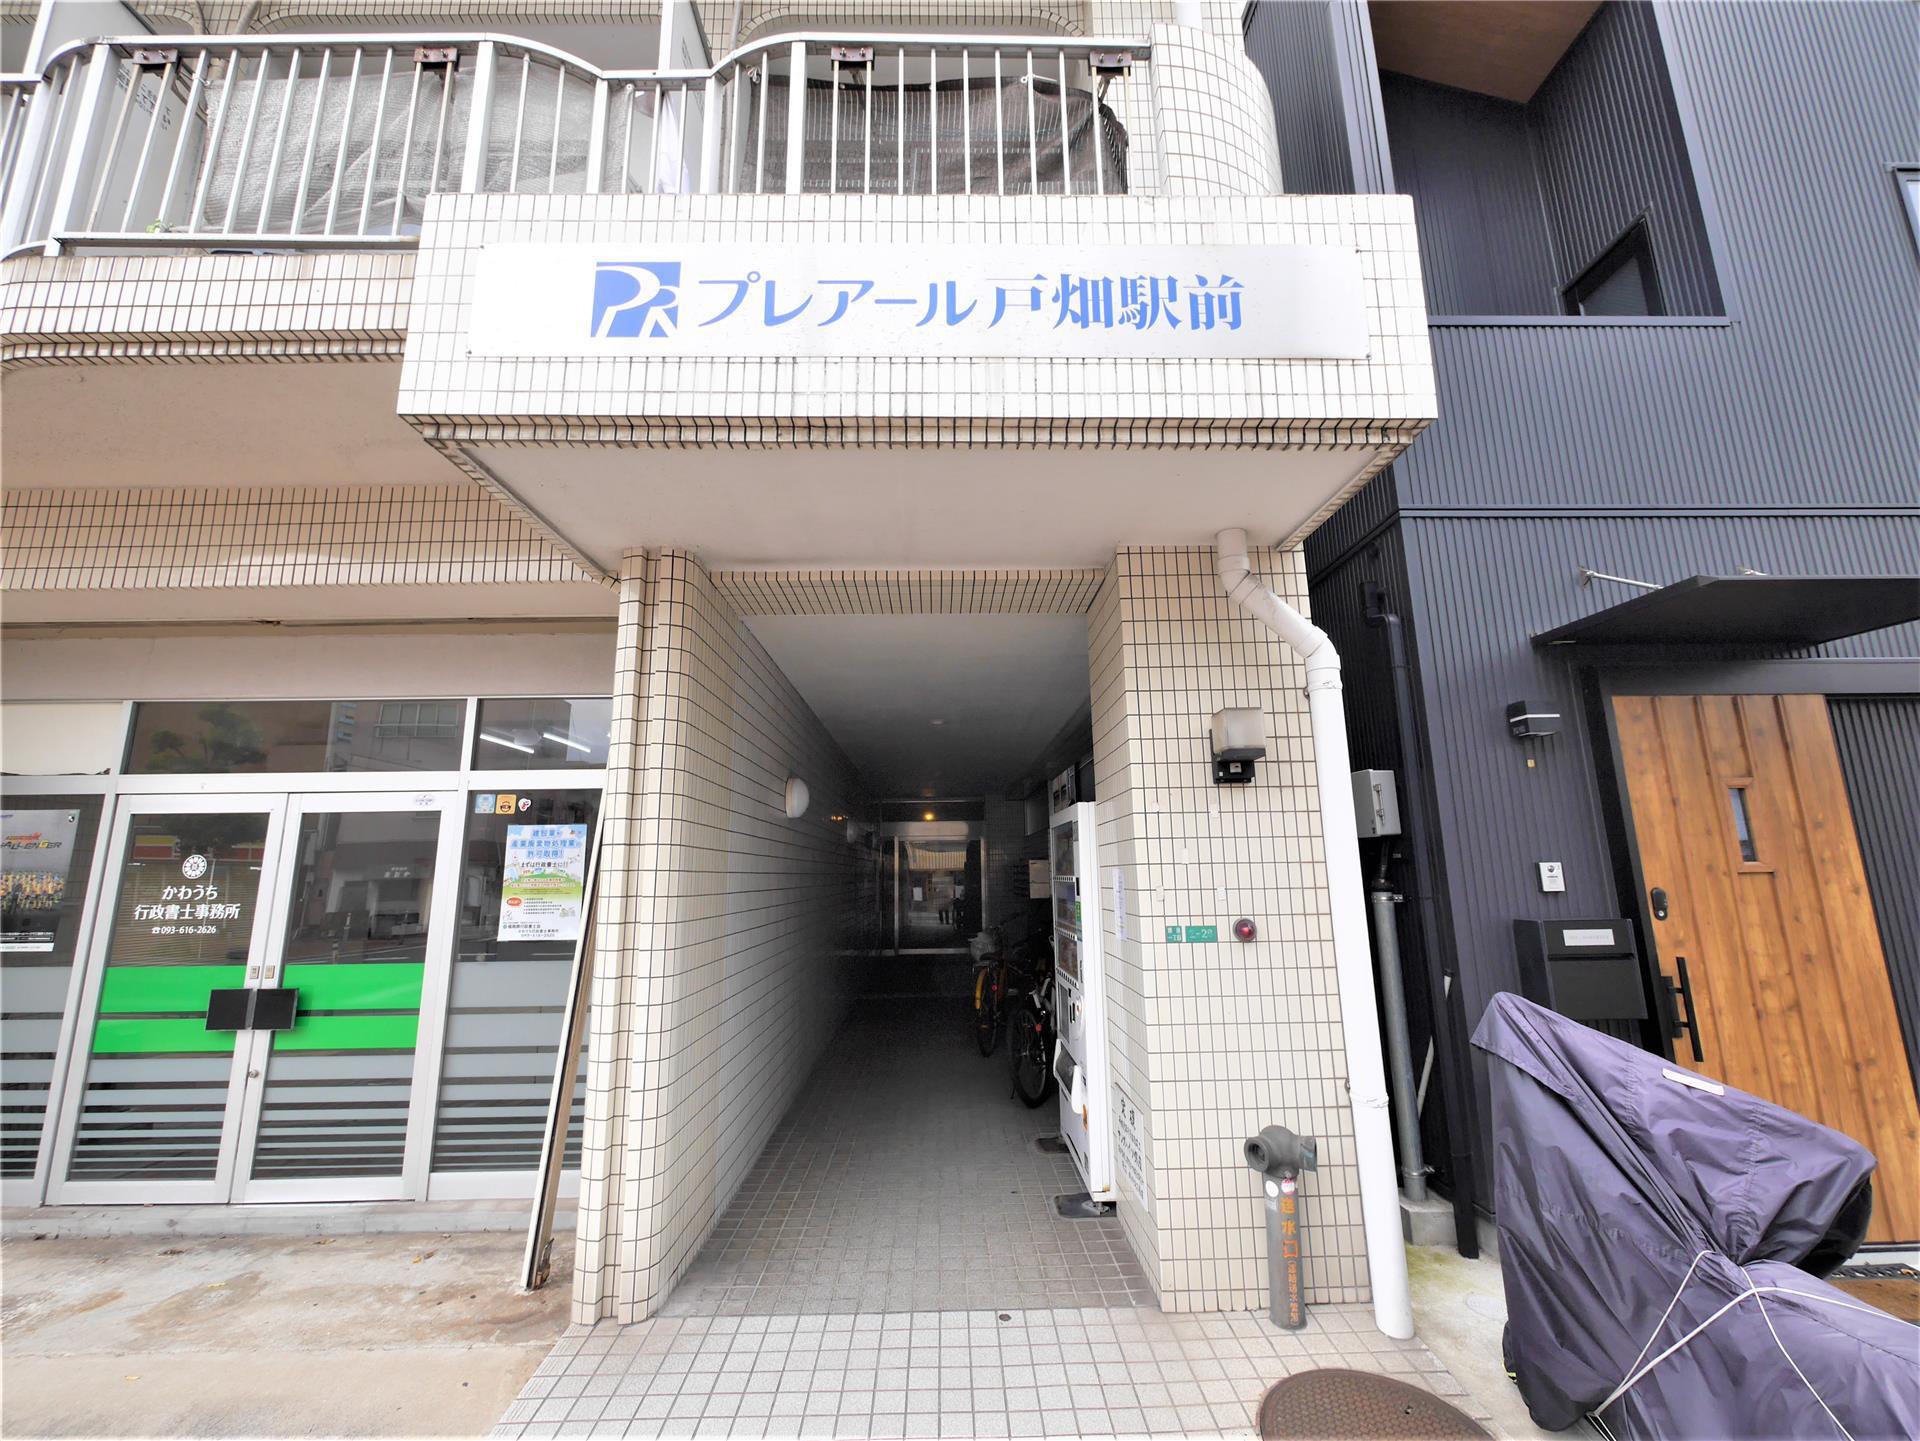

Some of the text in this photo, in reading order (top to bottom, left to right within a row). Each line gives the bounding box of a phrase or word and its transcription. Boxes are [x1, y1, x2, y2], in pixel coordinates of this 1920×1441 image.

[698, 271, 1246, 331] プレアール戸畑駅前
[162, 884, 218, 900] かわうち
[134, 903, 241, 920] 行政書士事務所
[161, 926, 217, 935] 093-616-2626
[1280, 1197, 1299, 1258] 送水口
